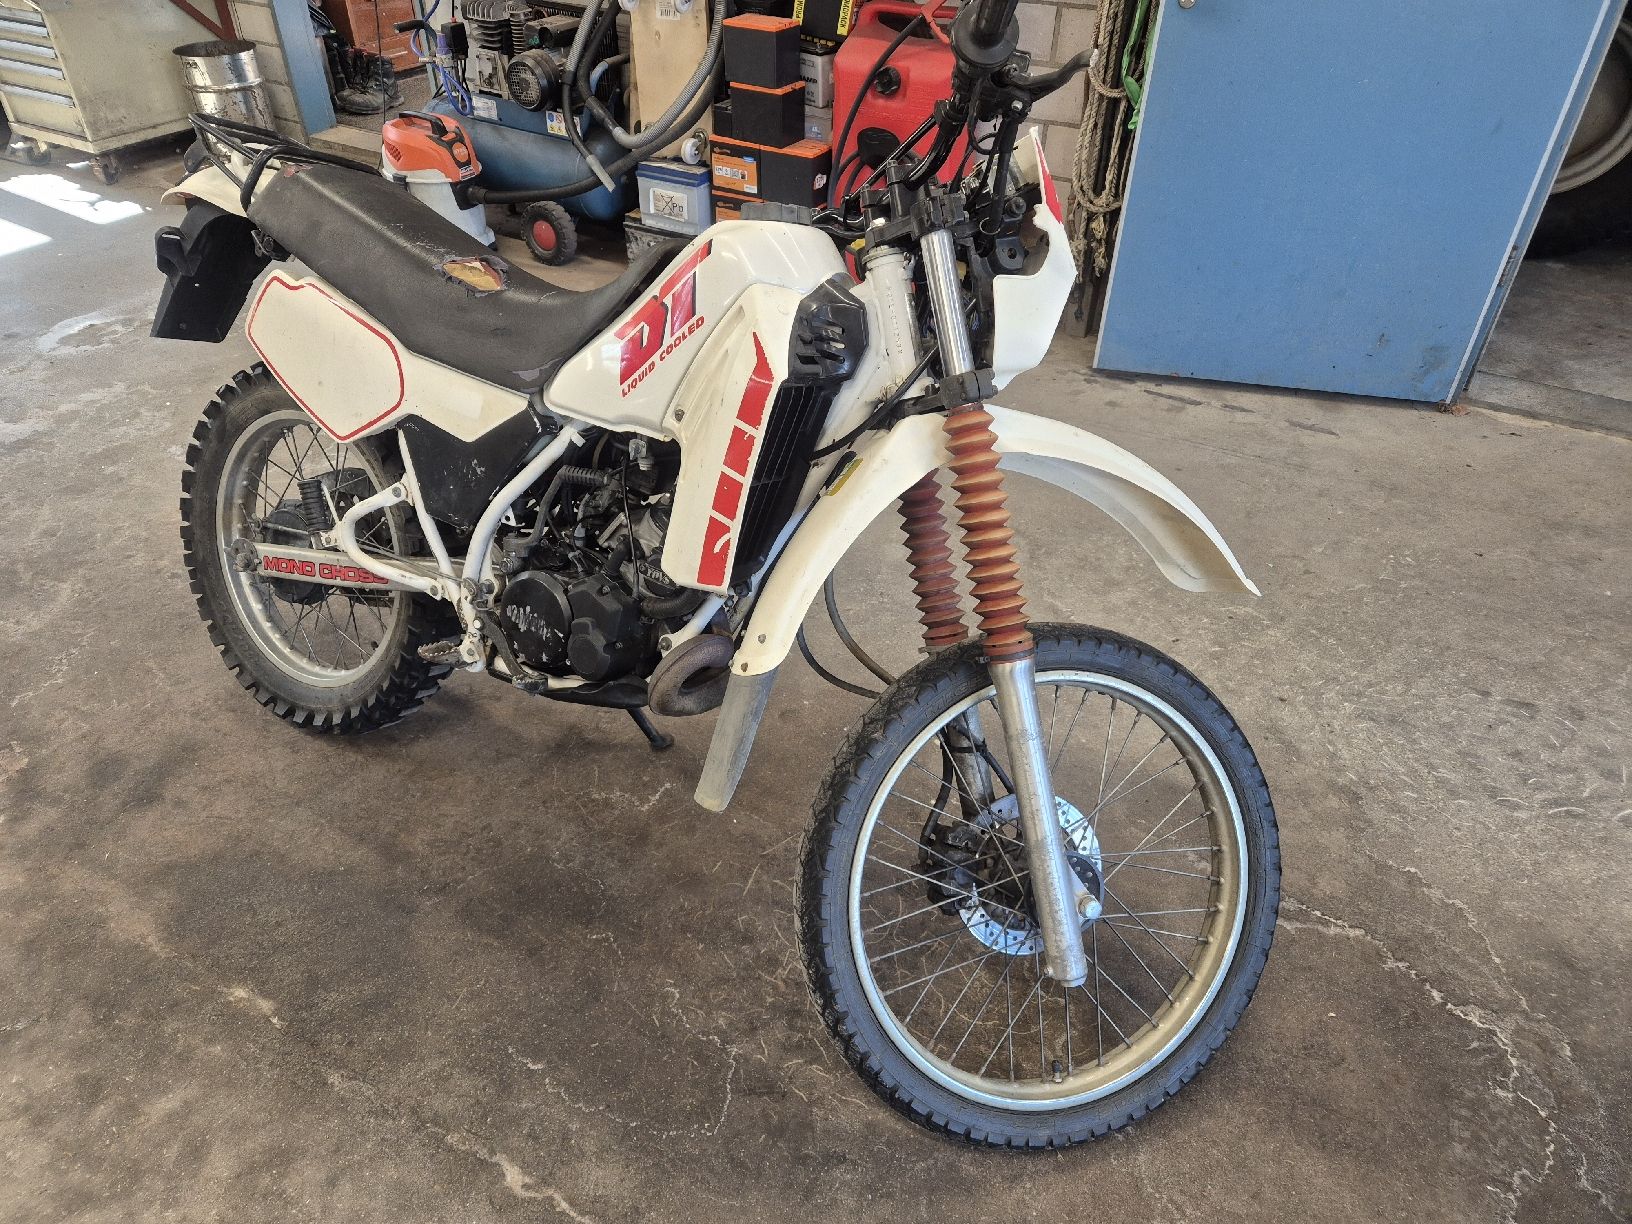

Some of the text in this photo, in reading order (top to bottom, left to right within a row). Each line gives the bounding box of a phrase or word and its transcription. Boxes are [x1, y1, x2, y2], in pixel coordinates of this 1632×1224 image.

[613, 238, 713, 386] DT
[621, 315, 705, 398] LIQUID COOLED
[263, 555, 316, 577] MONO
